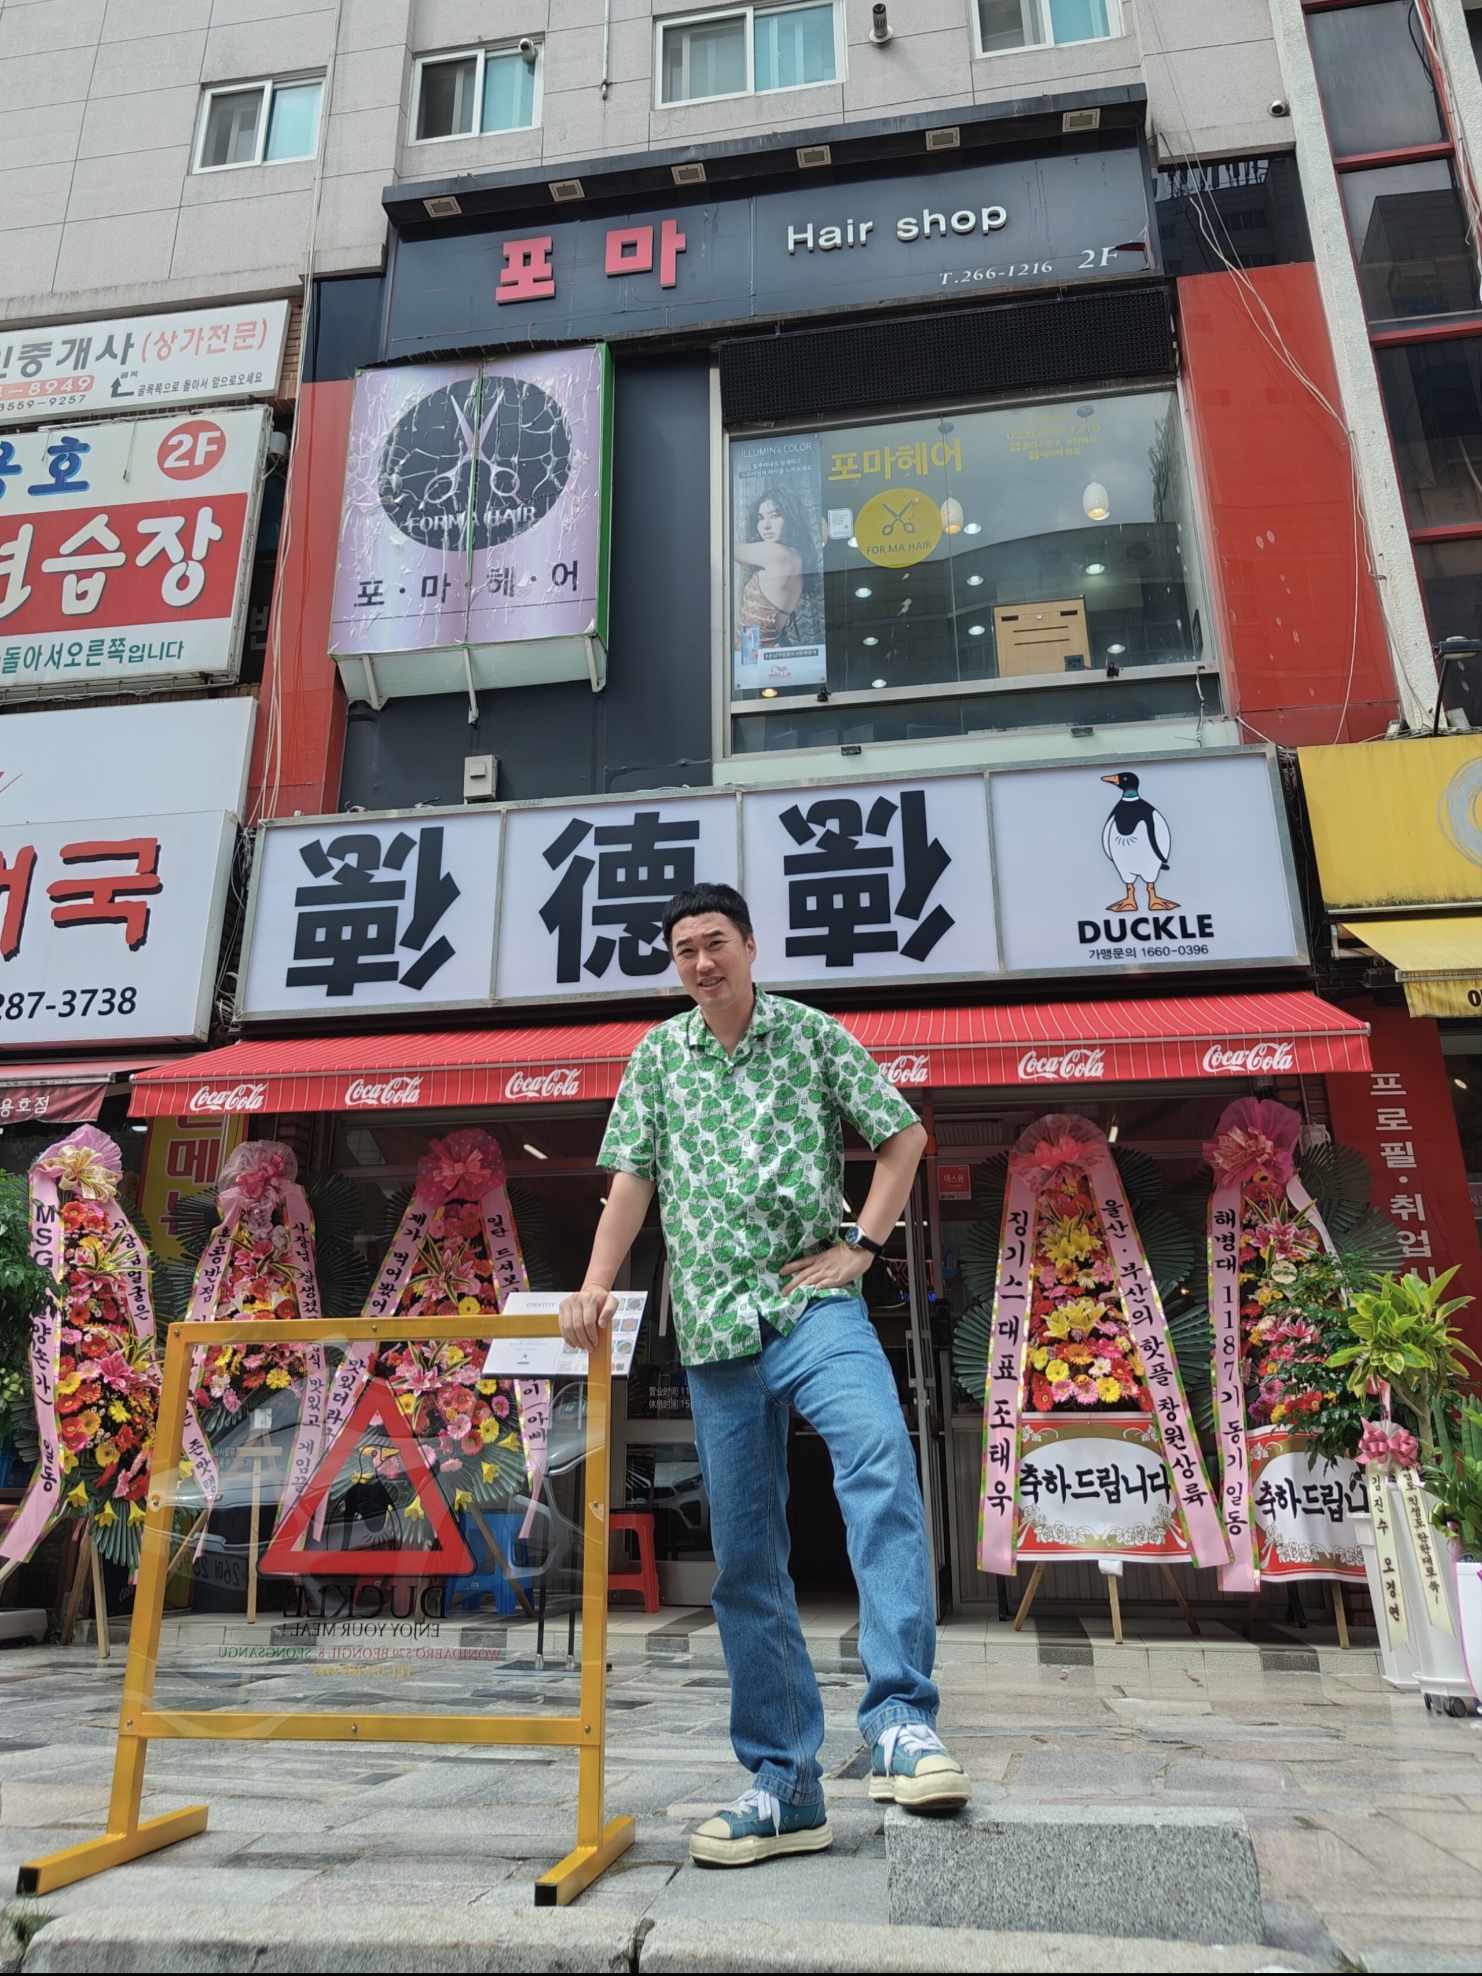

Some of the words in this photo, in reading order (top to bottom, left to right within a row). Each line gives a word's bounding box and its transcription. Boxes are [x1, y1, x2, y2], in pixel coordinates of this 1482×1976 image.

[787, 218, 873, 255] Hair
[896, 204, 1008, 242] shop
[939, 260, 1054, 286] T.266-1216
[1078, 245, 1119, 271] 2F
[0, 332, 136, 379] 중개사
[183, 377, 208, 392] 돌아서
[163, 429, 222, 469] 2F
[783, 442, 812, 454] COLOR
[828, 437, 962, 481] 포마헤어
[866, 543, 886, 555] FOR
[888, 542, 907, 554] MA
[907, 540, 933, 552] HAIR
[1077, 914, 1215, 944] DUCKLE
[1089, 946, 1137, 960] 가맹문의
[1141, 944, 1209, 958] 1660-0396
[1018, 1047, 1106, 1079] Coca-Cola
[1202, 1041, 1294, 1074] Coca-Cola
[190, 1083, 268, 1112] Coca-Cola
[344, 1075, 424, 1107] Coca-Cola
[504, 1068, 582, 1100] Coca-Cola
[34, 1204, 55, 1268] MSG
[291, 1221, 310, 1263] 사장님
[403, 1212, 427, 1242] 제가
[486, 1214, 509, 1238] 일단
[1213, 1208, 1237, 1276] 해병대
[1000, 1209, 1031, 1301] 징기스
[992, 1314, 1020, 1383] 대표
[986, 1399, 1016, 1517] 조태욱
[1222, 1419, 1245, 1473] 동기
[1223, 1480, 1250, 1537] 일동
[1371, 1474, 1389, 1537] 김진수
[1382, 1555, 1401, 1623] 오경연
